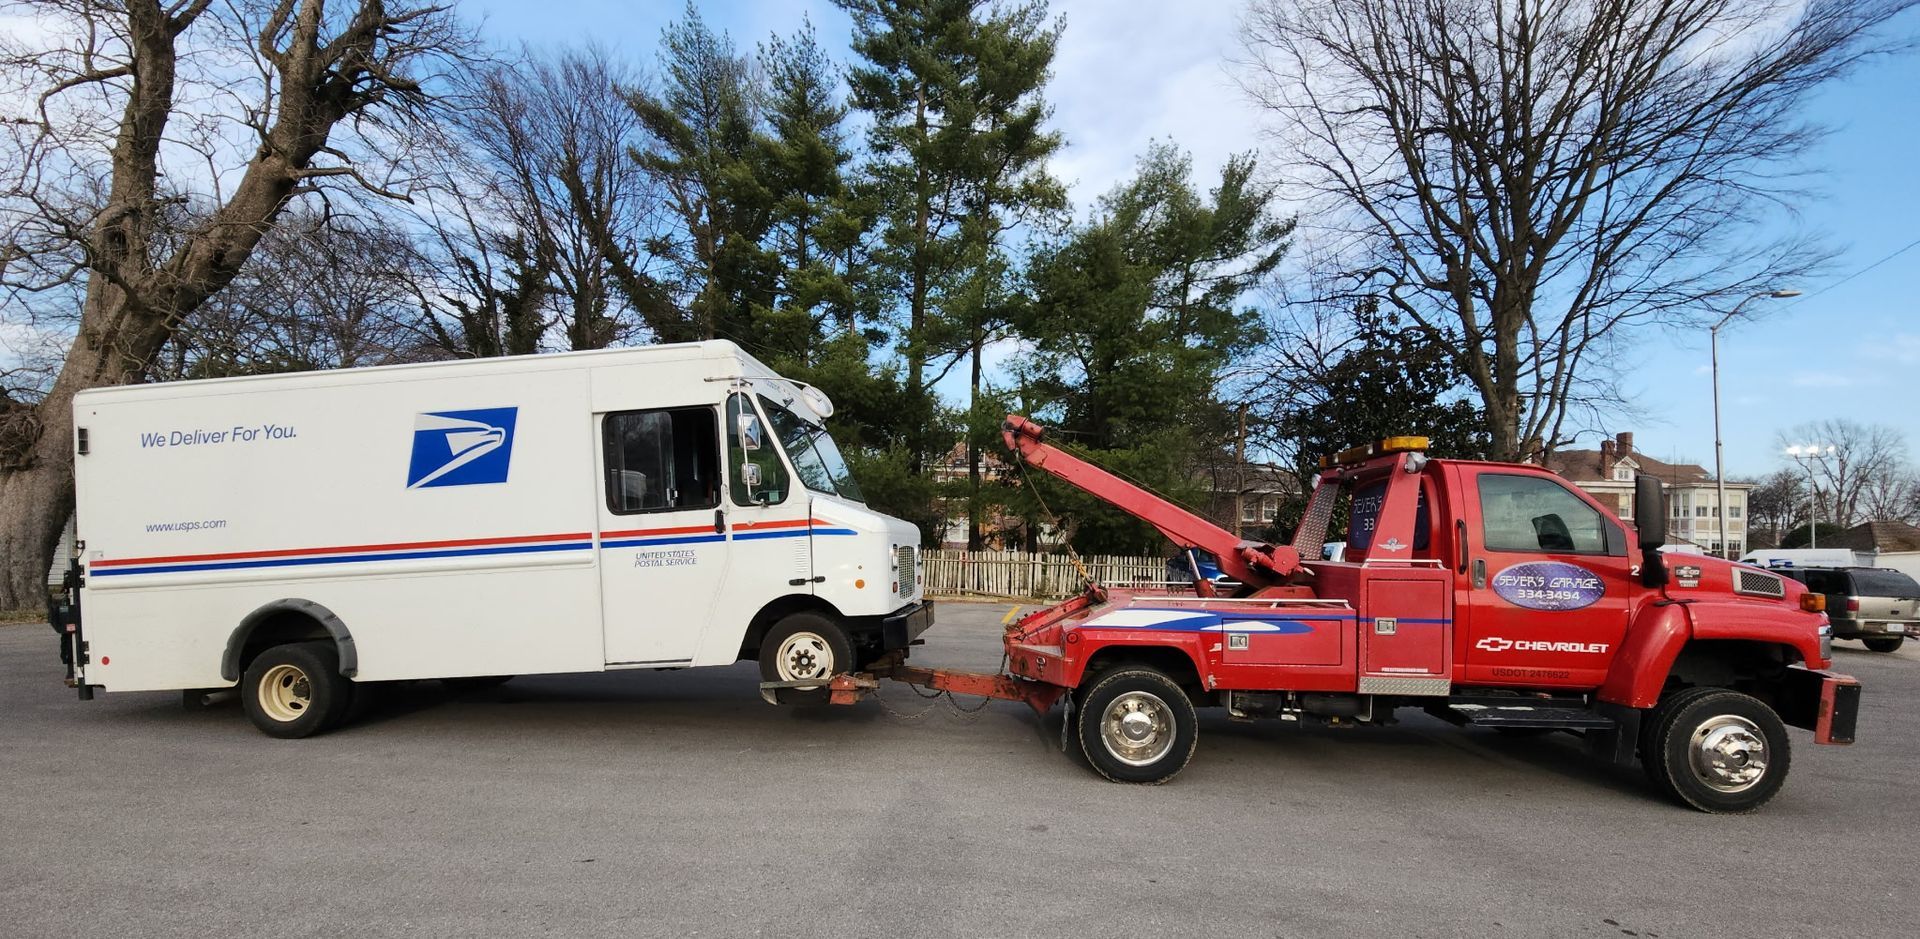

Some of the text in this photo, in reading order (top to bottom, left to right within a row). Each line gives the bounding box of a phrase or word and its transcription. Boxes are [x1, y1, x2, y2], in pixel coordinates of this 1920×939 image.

[141, 424, 297, 448] We Deliver For You.
[146, 519, 227, 532] www.usps.com
[636, 550, 695, 560] UNITED STATES
[635, 557, 697, 568] POSTAL SERVICE
[1630, 564, 1640, 576] 2
[1499, 575, 1599, 589] SEYER'S GARAGE
[1518, 589, 1581, 601] 334-3494
[1515, 640, 1610, 653] CHEVROLET
[1492, 667, 1528, 677] USDOT
